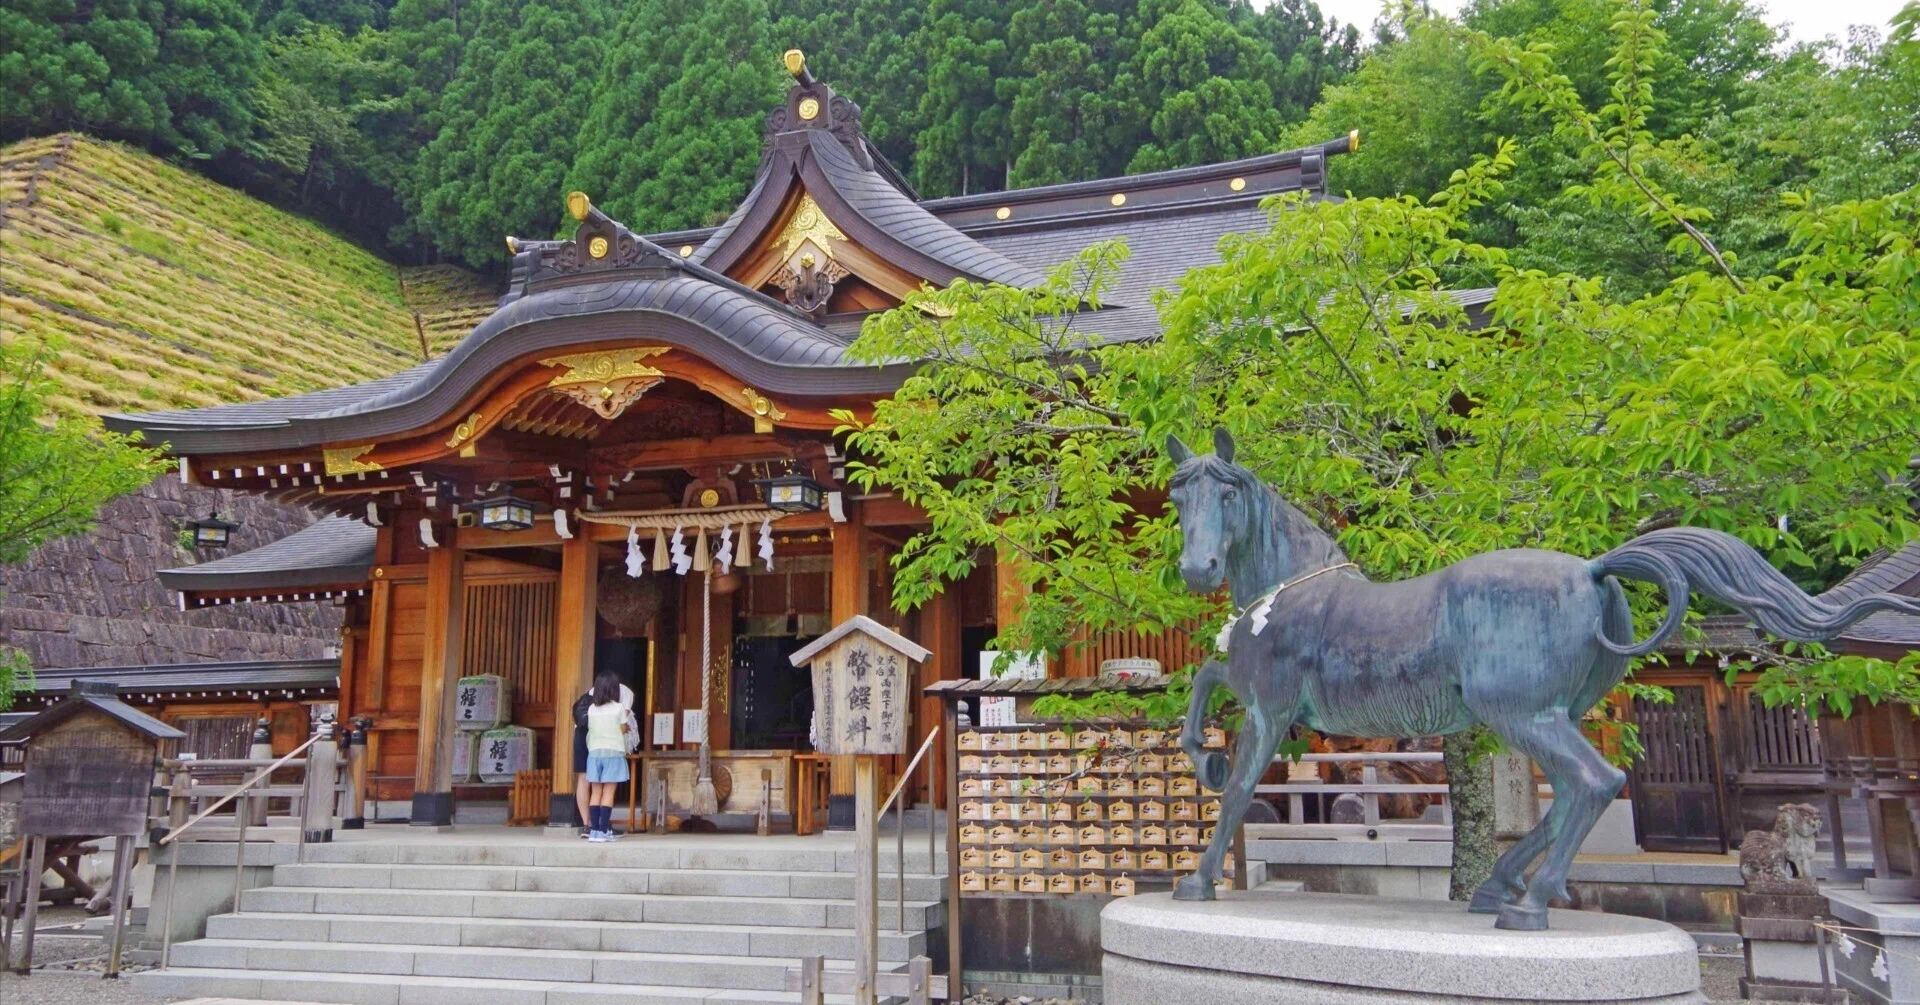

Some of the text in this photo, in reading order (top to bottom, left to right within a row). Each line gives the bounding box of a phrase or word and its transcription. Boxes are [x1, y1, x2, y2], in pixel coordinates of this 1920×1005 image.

[887, 655, 897, 677] 天皇
[845, 649, 872, 746] 幣饌料
